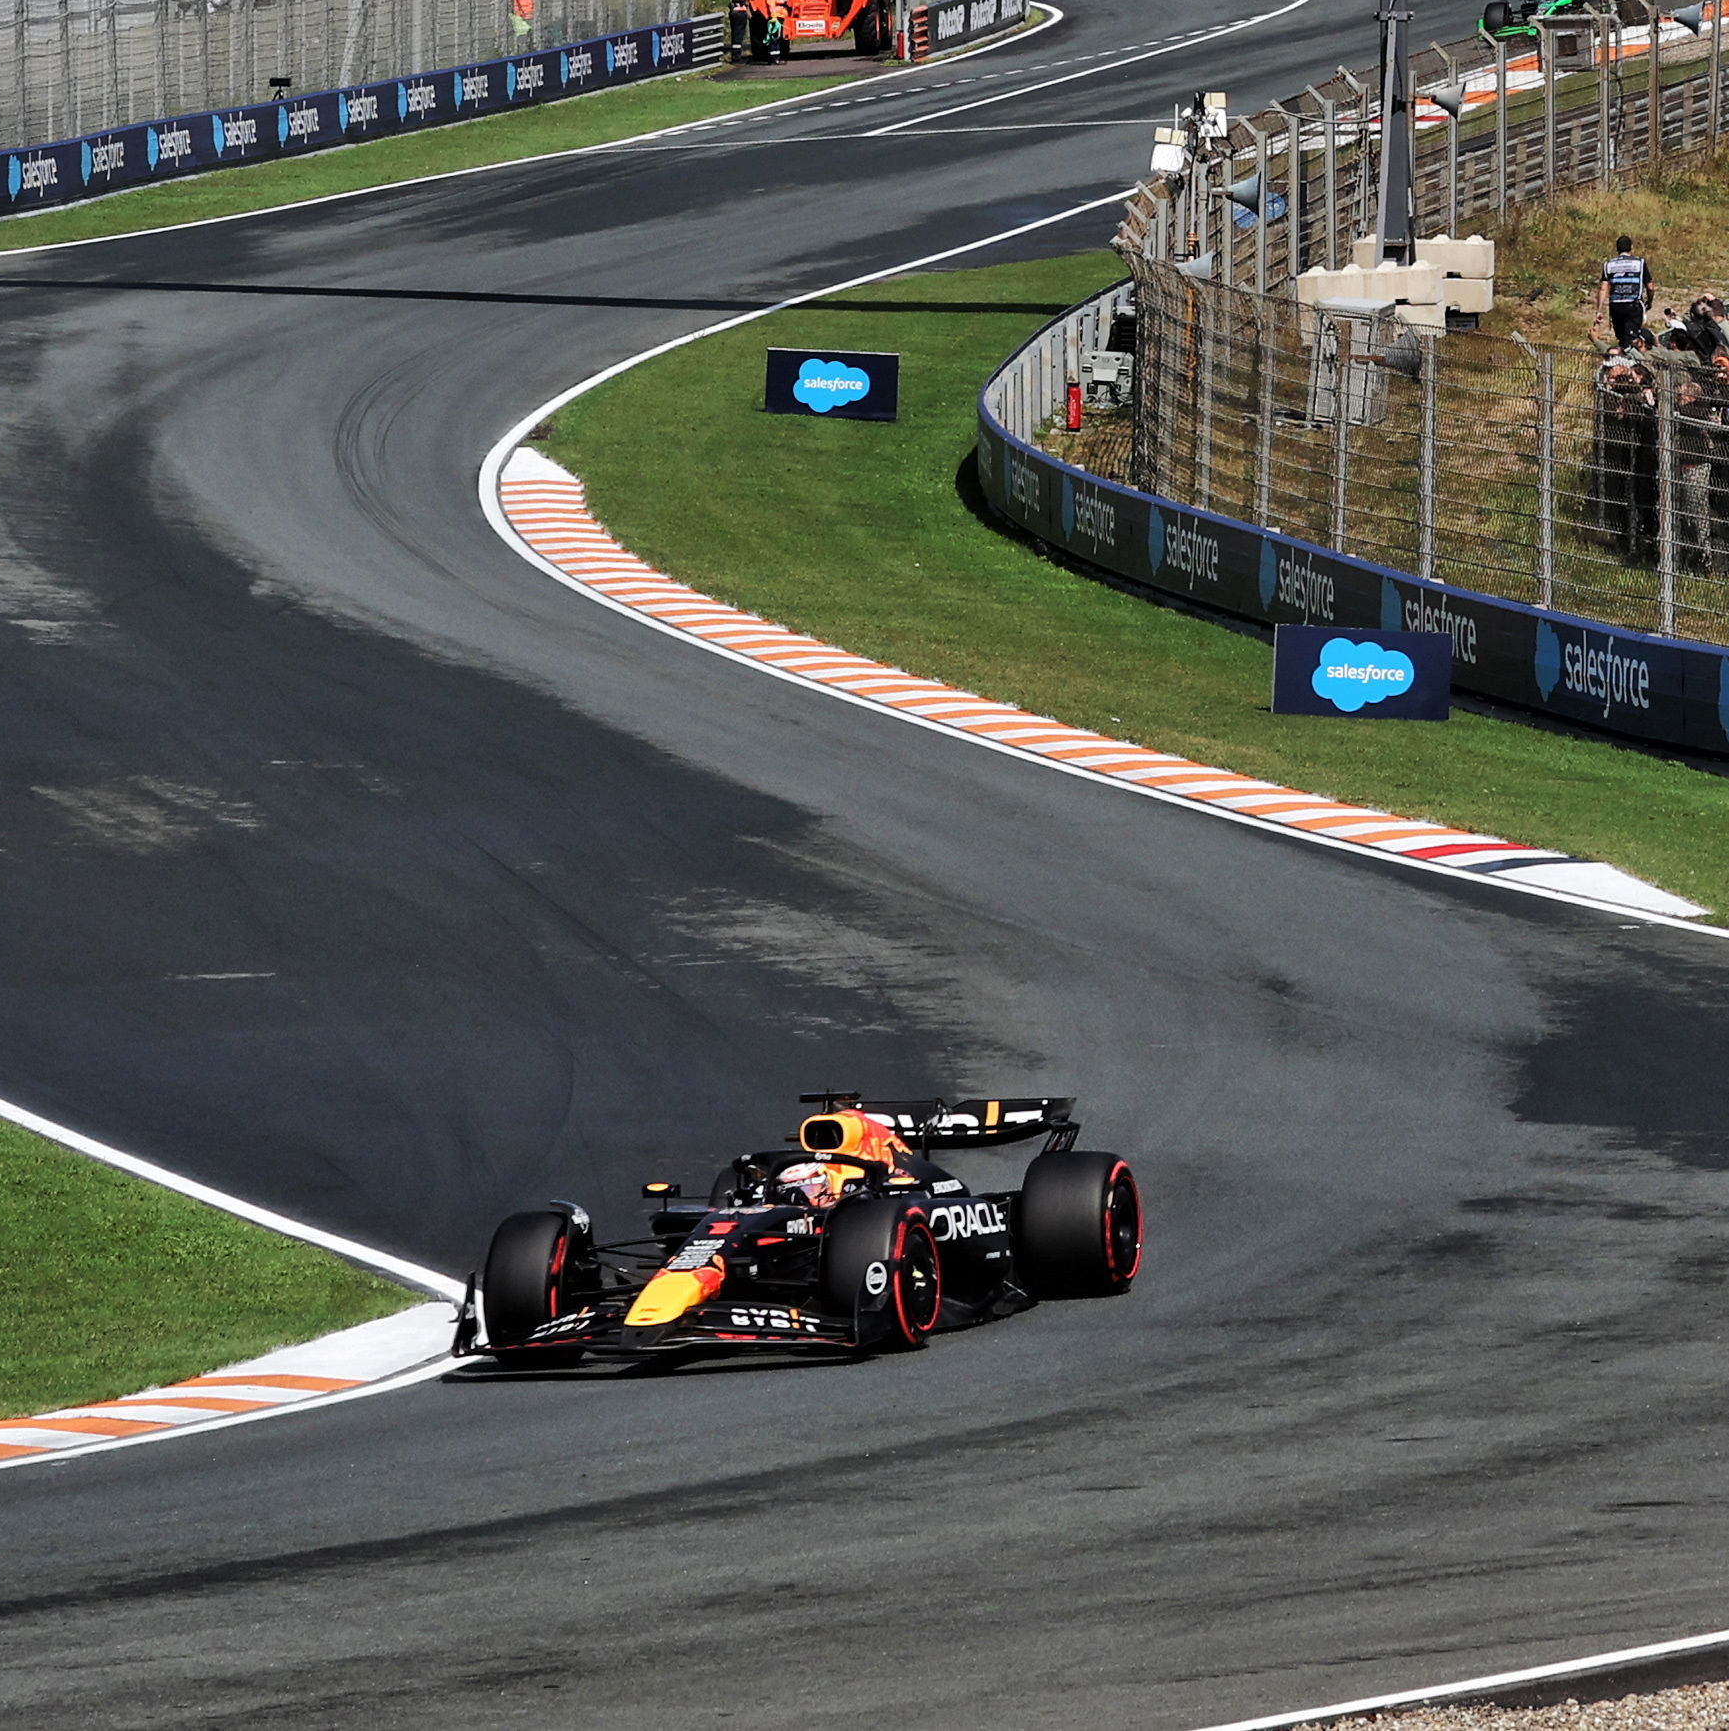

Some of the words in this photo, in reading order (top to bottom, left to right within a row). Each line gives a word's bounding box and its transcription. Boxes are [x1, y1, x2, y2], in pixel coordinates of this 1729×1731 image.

[23, 150, 58, 198] salesforce
[804, 377, 863, 392] salesforce
[1075, 478, 1115, 555] salesforce
[1166, 511, 1219, 590] salesforce
[1279, 547, 1334, 626] salesforce
[1327, 664, 1405, 684] salesforce
[1565, 640, 1650, 717] salesforce
[929, 1202, 1006, 1241] ORACLE
